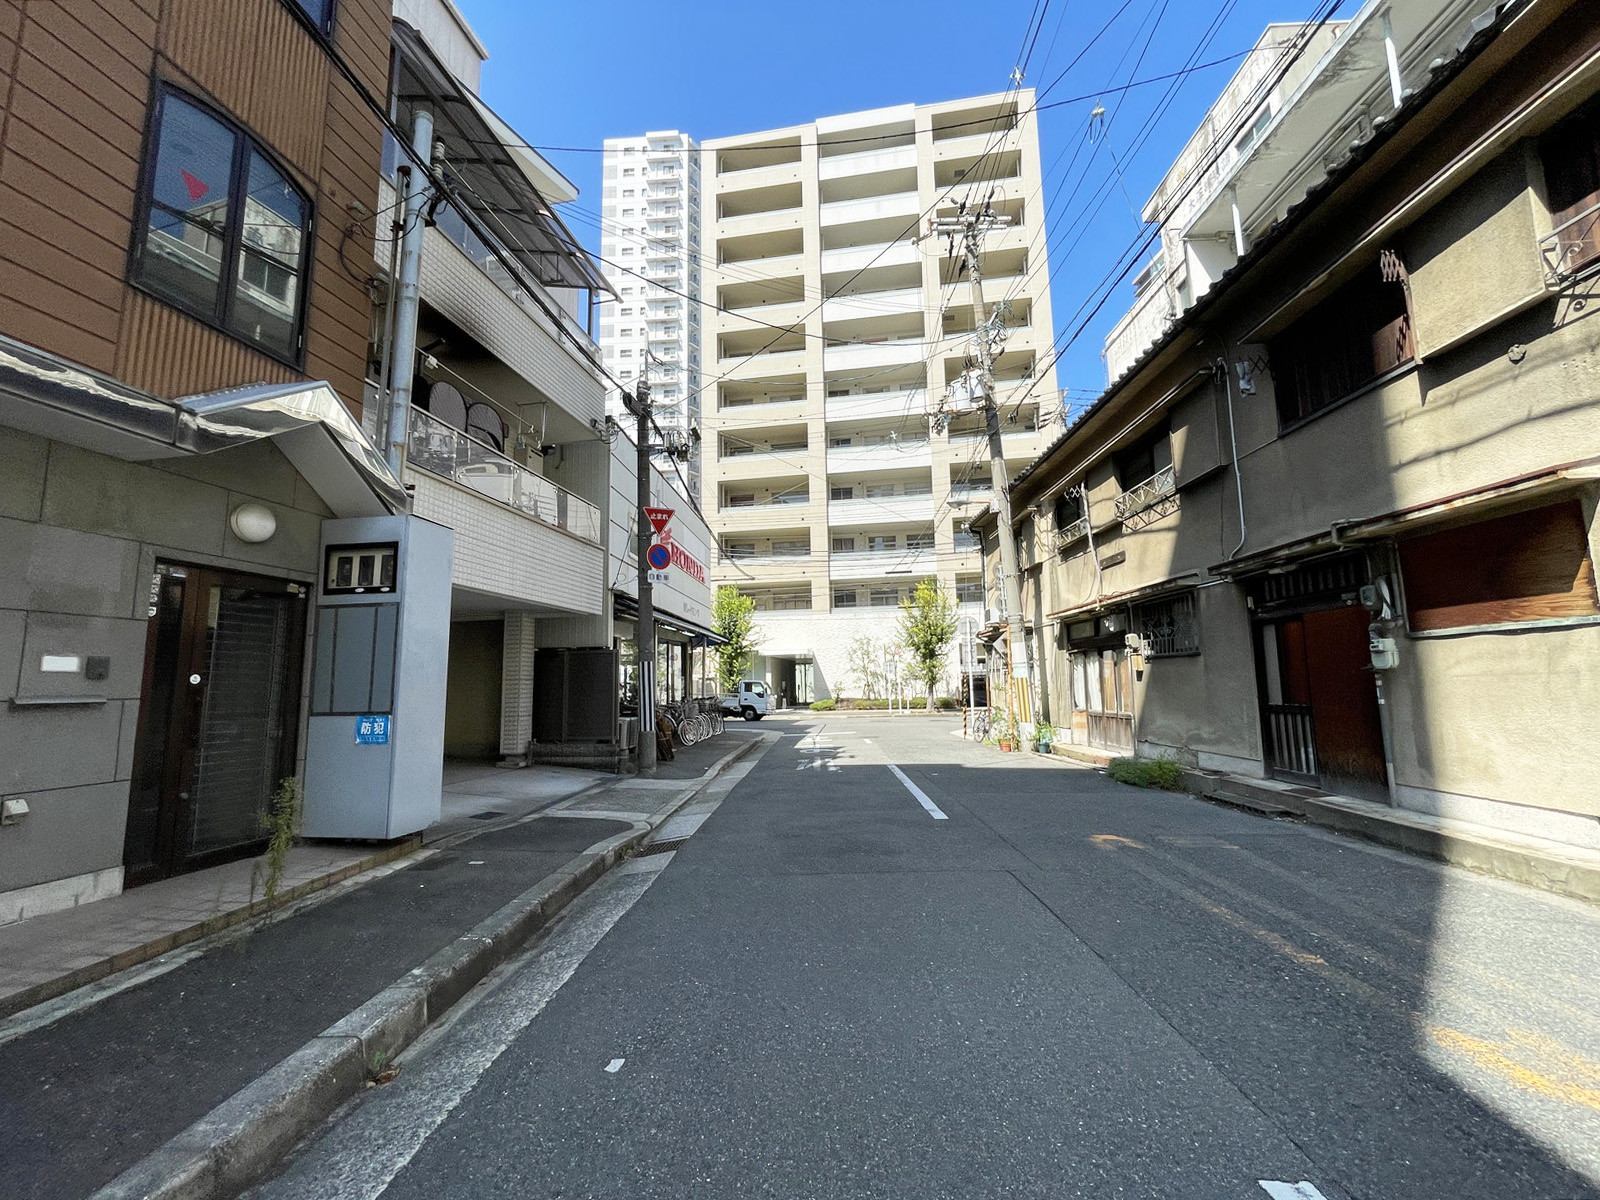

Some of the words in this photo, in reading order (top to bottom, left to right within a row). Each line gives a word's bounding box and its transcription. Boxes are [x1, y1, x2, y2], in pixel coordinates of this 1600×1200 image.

[670, 541, 706, 584] HONDA
[649, 573, 670, 581] 自動車
[360, 722, 385, 735] 防犯
